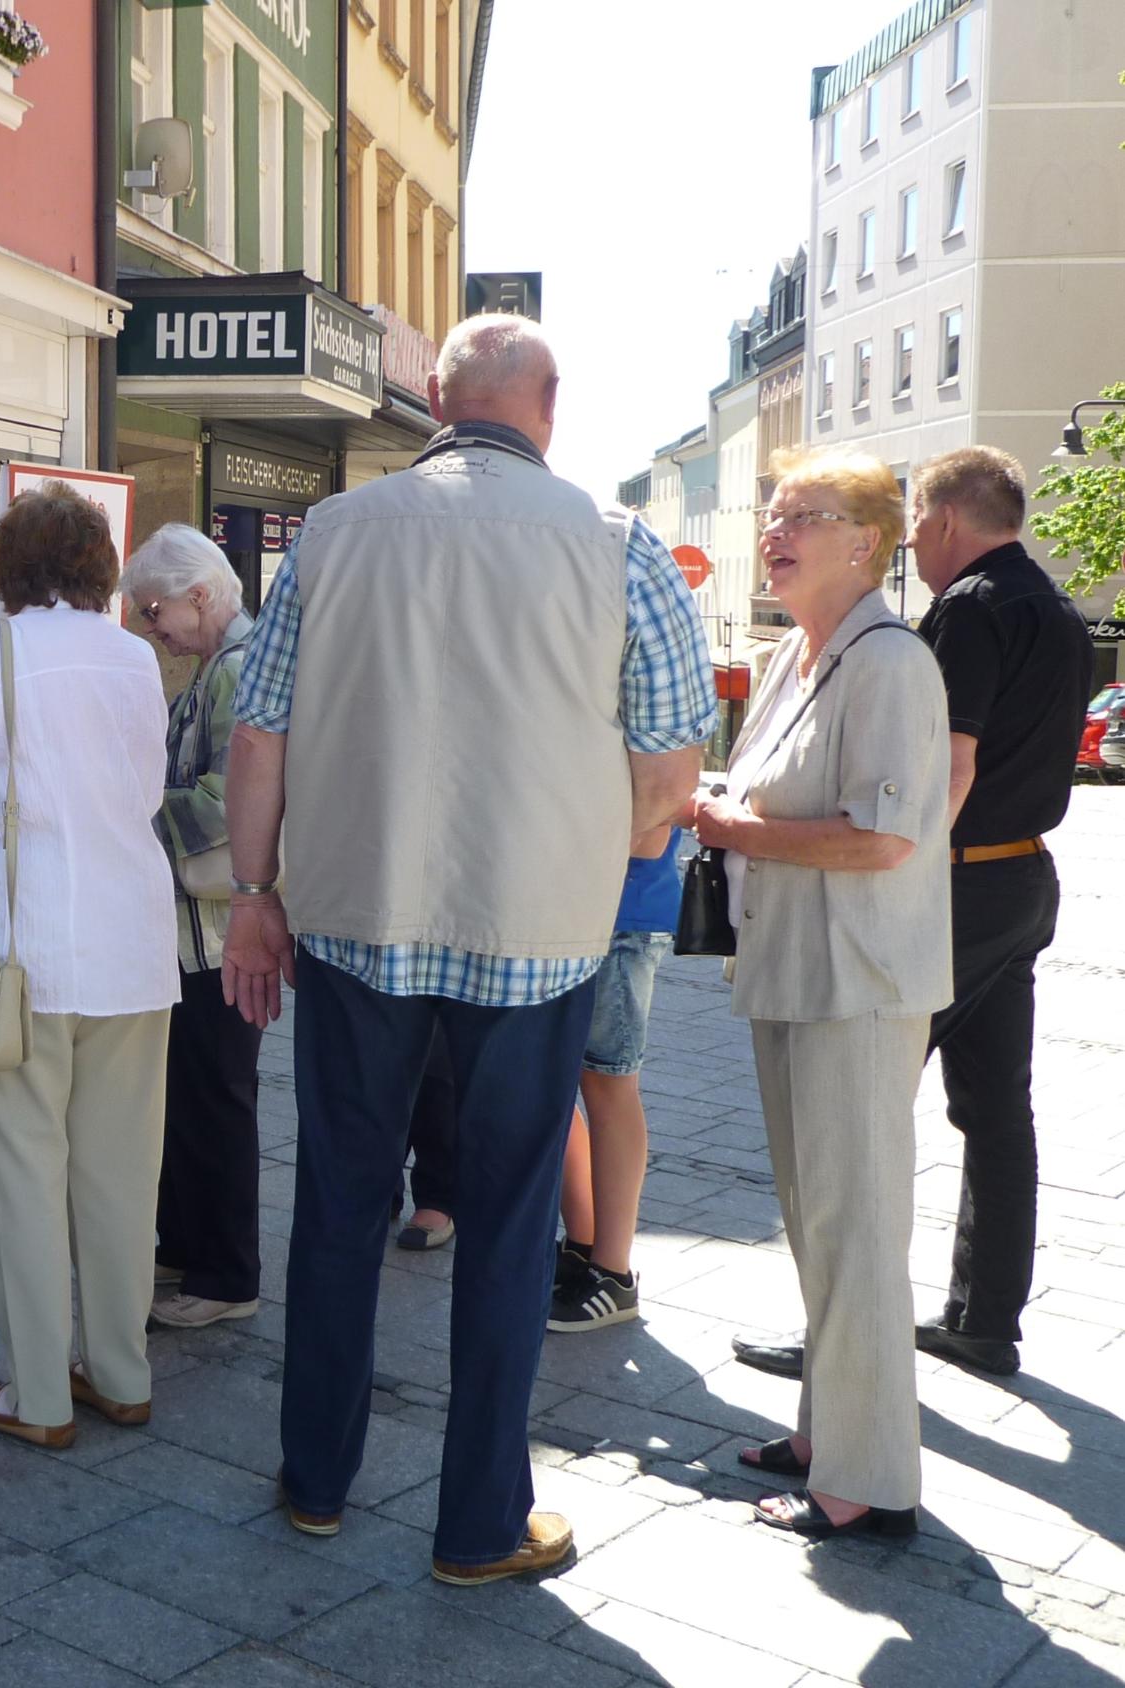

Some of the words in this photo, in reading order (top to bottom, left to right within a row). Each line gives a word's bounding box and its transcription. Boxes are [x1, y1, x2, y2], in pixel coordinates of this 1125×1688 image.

[155, 311, 297, 359] HOTEL
[313, 306, 364, 369] Sächsischer
[365, 333, 380, 377] Hof
[333, 365, 362, 390] GARAGEN
